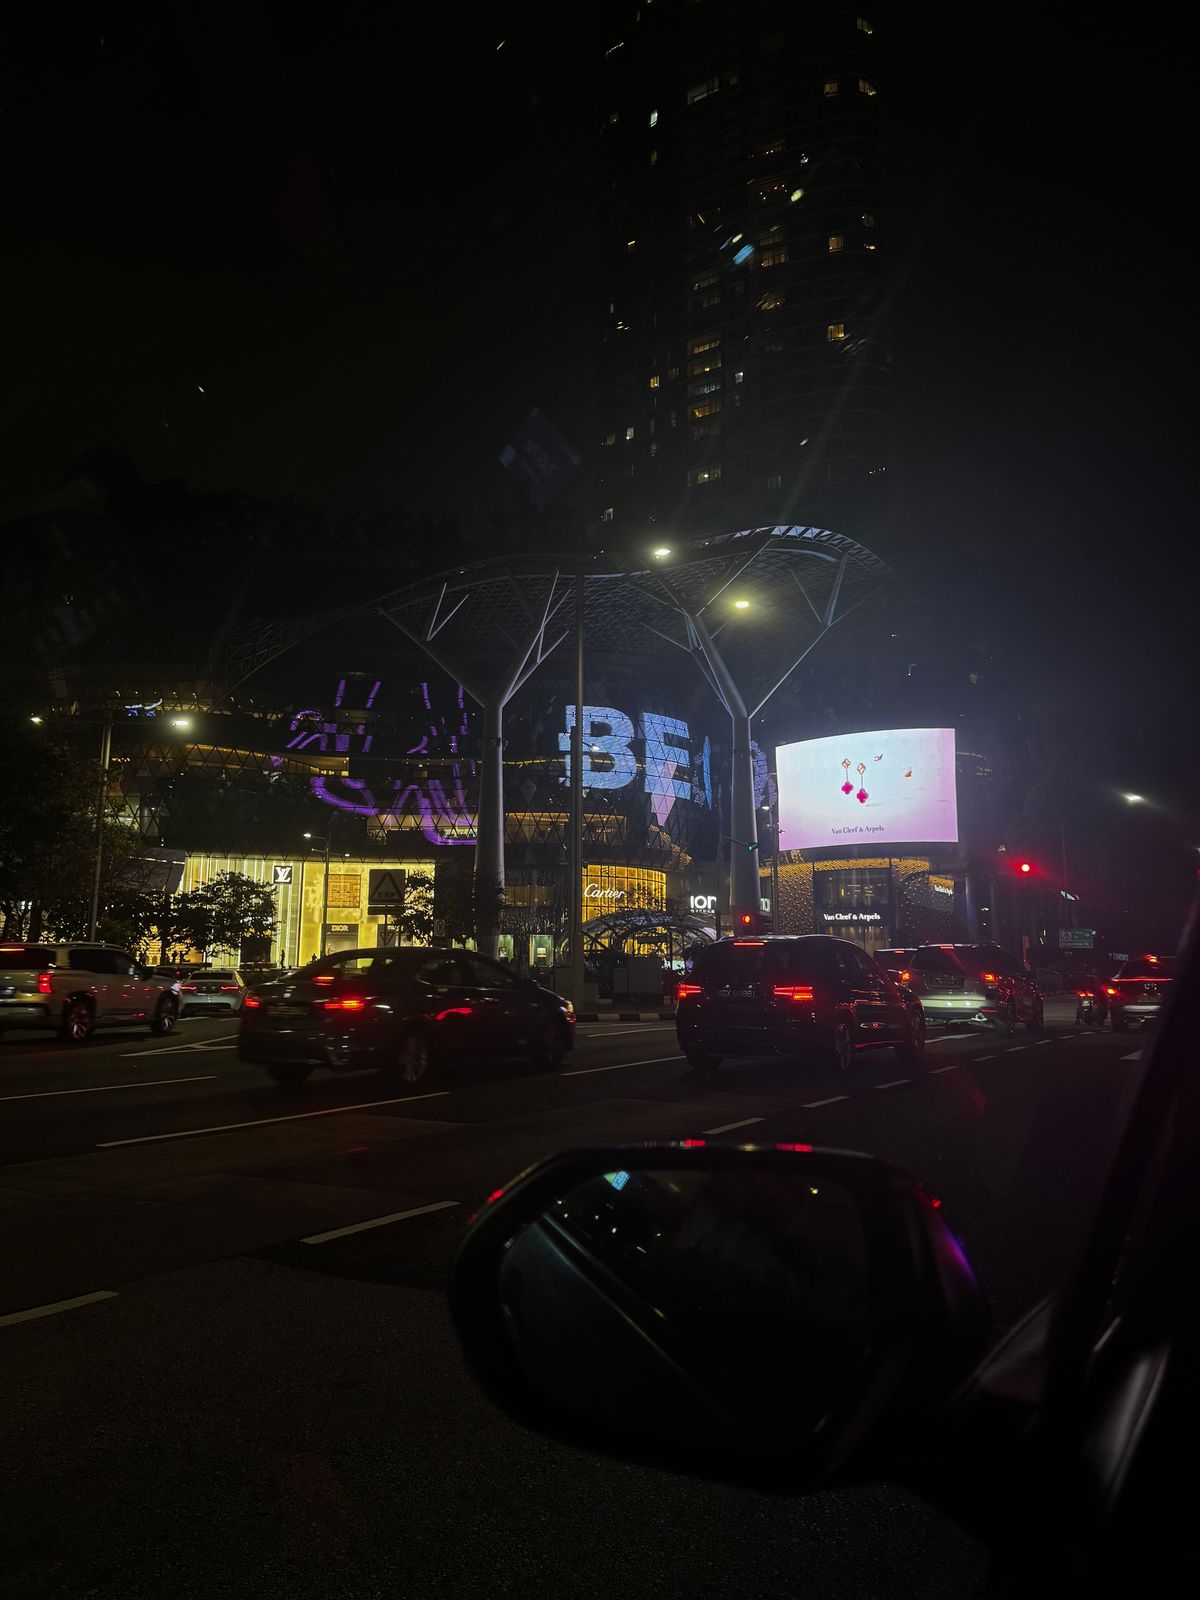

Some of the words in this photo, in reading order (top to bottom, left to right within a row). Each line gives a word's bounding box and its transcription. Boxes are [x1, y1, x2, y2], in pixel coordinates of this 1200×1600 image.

[831, 827, 842, 835] Van
[842, 826, 858, 834] Cleef
[864, 825, 885, 834] Arpels
[584, 883, 625, 899] Cartier
[823, 913, 835, 921] Van
[835, 912, 852, 920] Cleef
[858, 912, 881, 922] Arpels
[331, 924, 349, 932] DIOR
